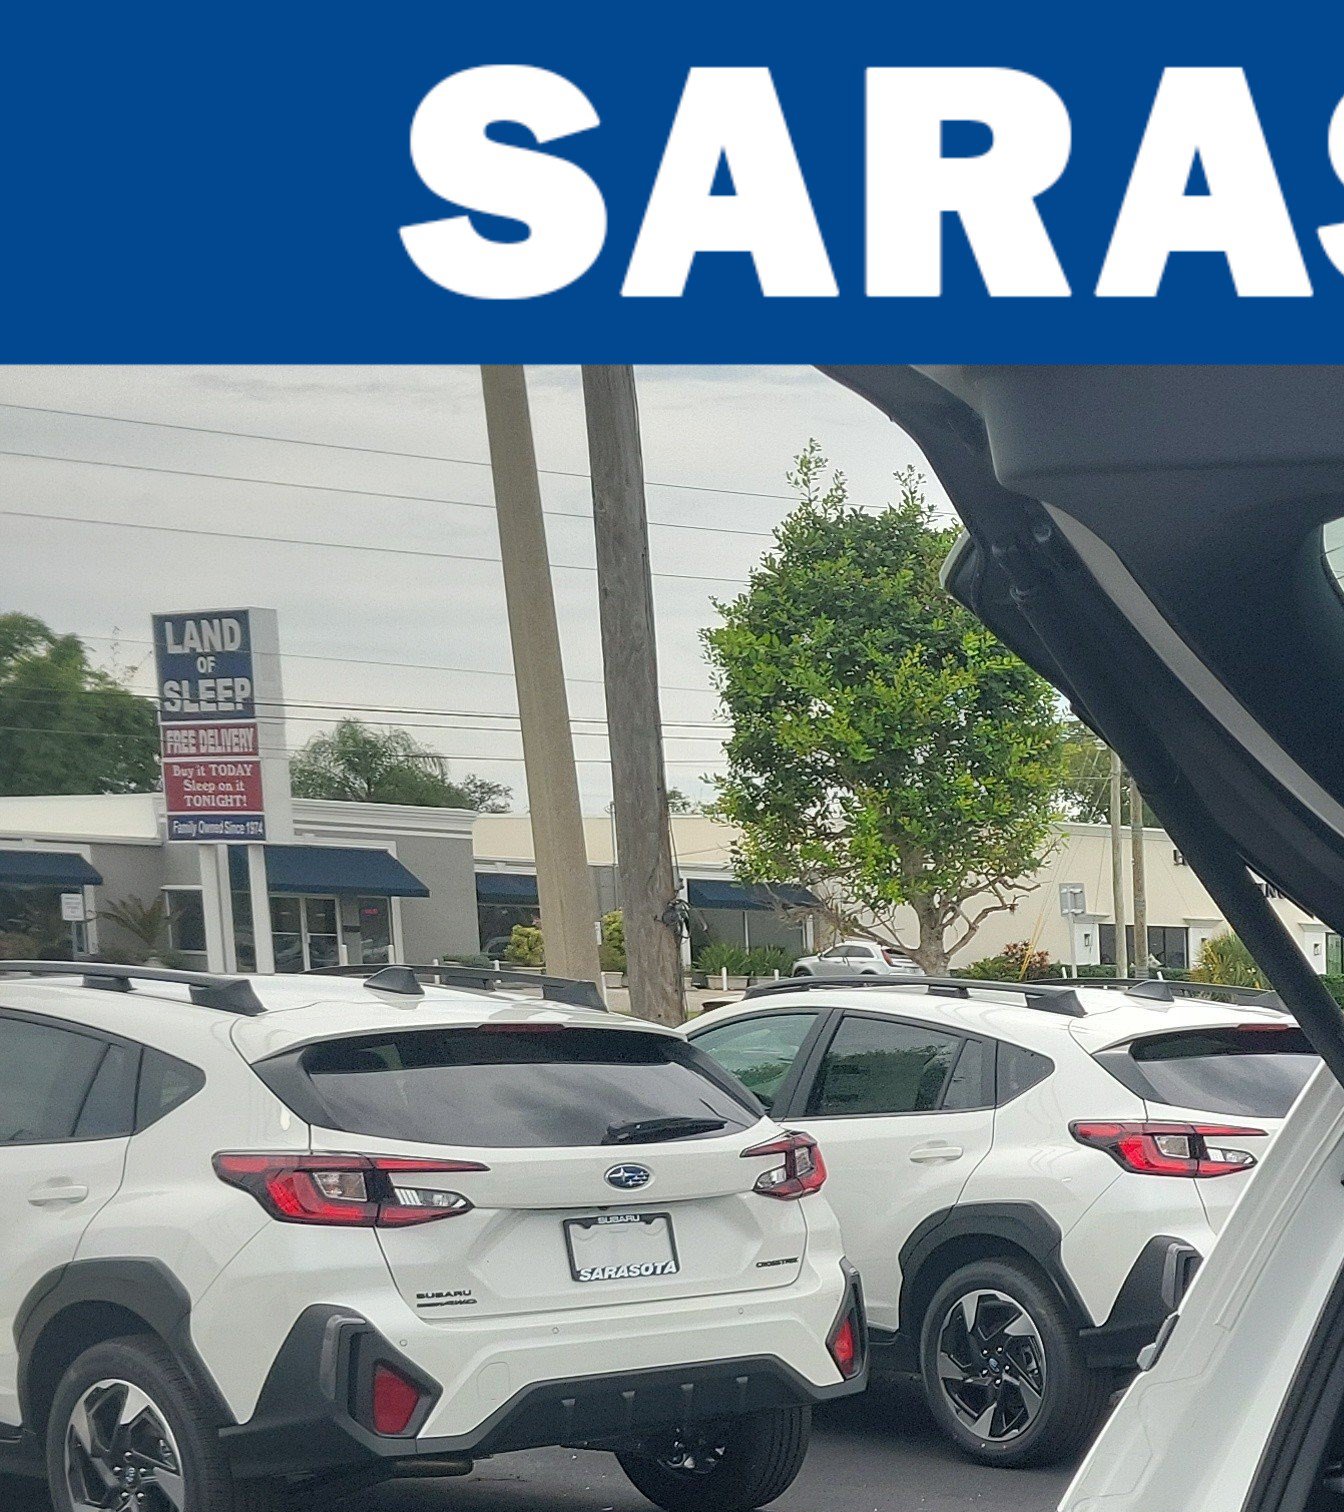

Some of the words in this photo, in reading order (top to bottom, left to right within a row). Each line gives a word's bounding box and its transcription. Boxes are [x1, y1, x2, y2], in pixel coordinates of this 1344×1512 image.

[164, 618, 241, 654] LAND
[196, 656, 216, 674] OF
[163, 677, 251, 712] SLEEP
[166, 730, 197, 754] FREE
[198, 728, 254, 753] DELIVERY
[173, 765, 194, 778] Buy
[197, 765, 206, 776] it
[208, 764, 253, 776] TODAY
[183, 780, 216, 793] Sleep
[218, 783, 233, 791] on
[235, 780, 245, 791] it
[184, 795, 248, 807] TONIGHT!
[597, 1214, 640, 1224] SUBARU
[579, 1260, 677, 1282] SARASOTA
[416, 1289, 471, 1299] SUBARU
